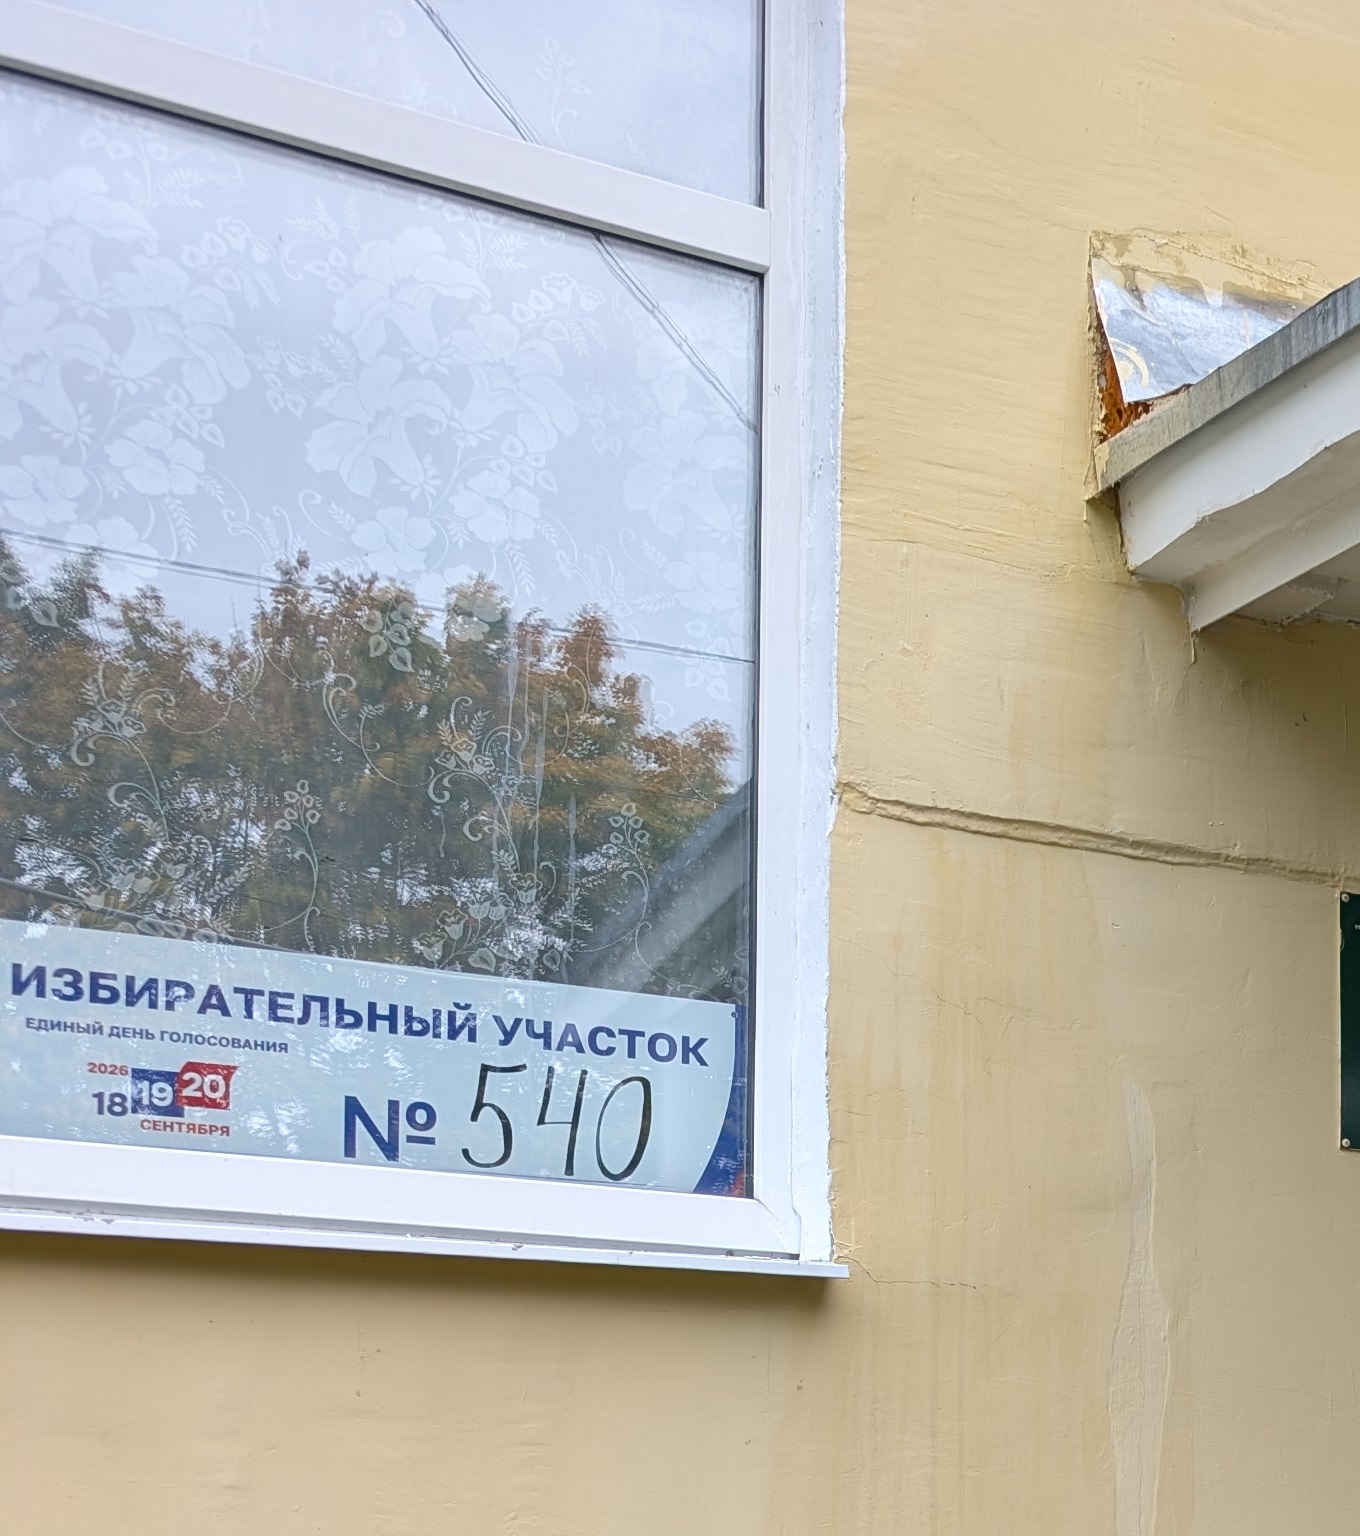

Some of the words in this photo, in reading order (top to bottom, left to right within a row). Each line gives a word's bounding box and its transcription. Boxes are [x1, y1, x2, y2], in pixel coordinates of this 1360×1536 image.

[11, 963, 478, 1044] ИЗБИРАТЕЛЬНЫЙ
[497, 1014, 709, 1067] УЧАСТОК
[25, 1016, 104, 1039] ЕДИНЫЙ
[108, 1025, 157, 1043] ДЕНЬ
[159, 1029, 289, 1054] ГОЛОСОВАНИЯ
[87, 1062, 129, 1076] 2026
[92, 1091, 129, 1117] 18
[138, 1081, 173, 1107] 19
[182, 1072, 226, 1099] 20
[140, 1119, 230, 1136] СЕНТЯБРЯ
[344, 1095, 437, 1162] №
[461, 1063, 652, 1181] 540
